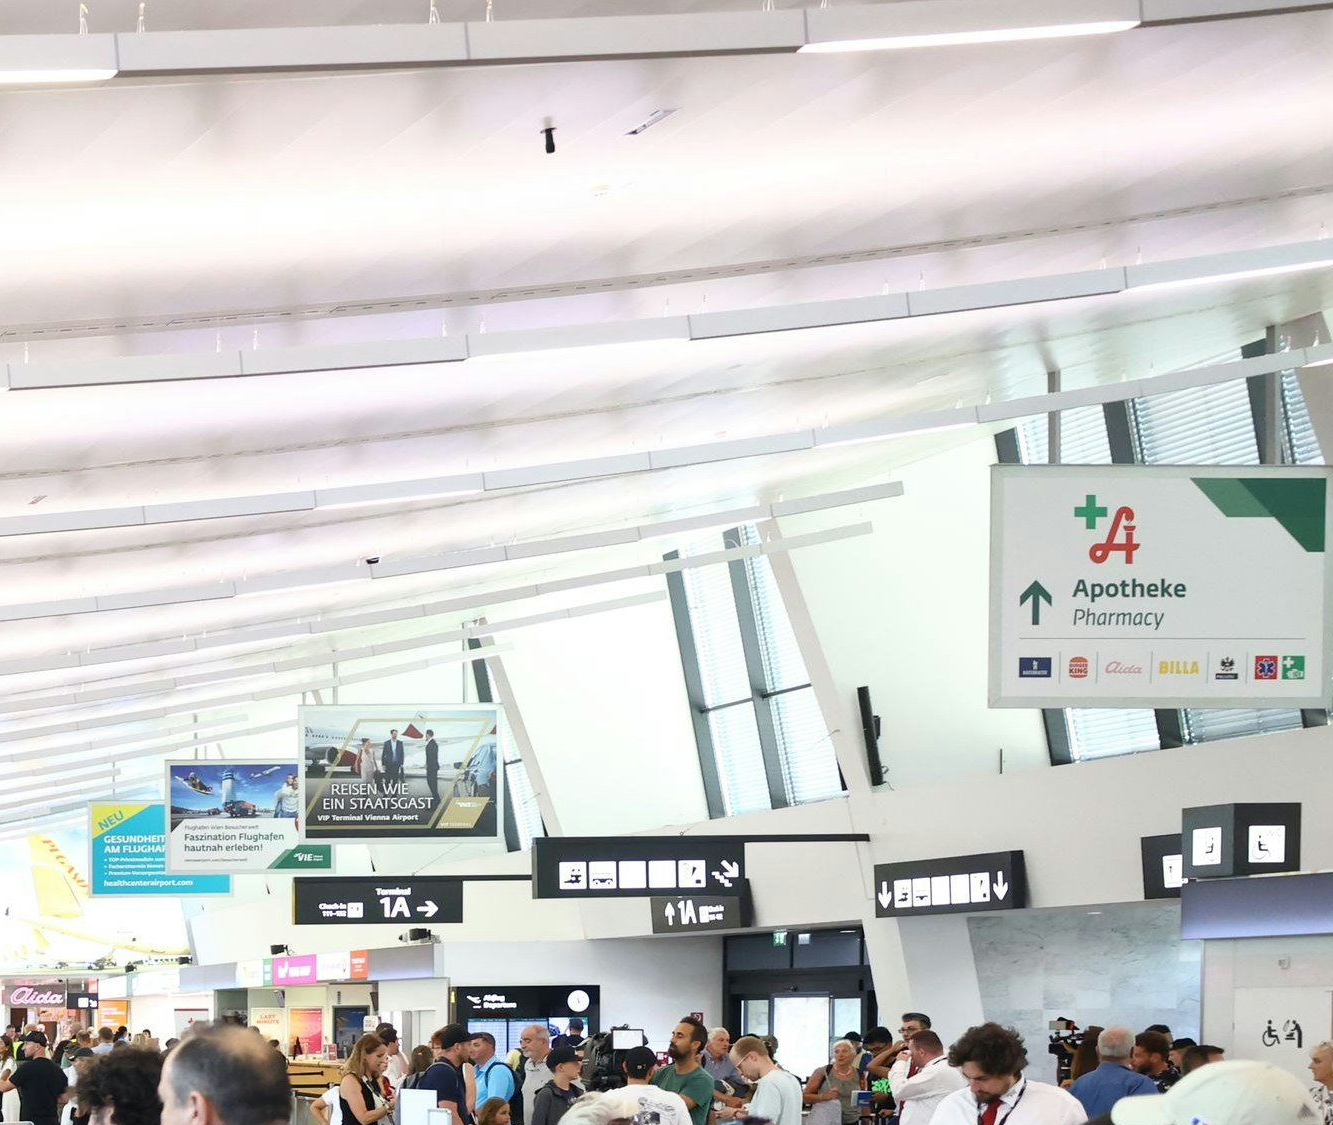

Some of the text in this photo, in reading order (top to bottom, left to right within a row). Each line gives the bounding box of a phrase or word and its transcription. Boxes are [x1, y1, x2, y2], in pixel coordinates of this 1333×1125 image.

[1072, 578, 1187, 603] Apotheke
[1073, 608, 1165, 631] Pharmacy
[1159, 660, 1199, 674] BILLA
[332, 783, 409, 795] REISEN WIE
[323, 797, 434, 810] EIN STAATSGAST
[98, 810, 124, 830] NEU
[317, 814, 330, 822] VIP
[392, 814, 419, 822] Airport
[184, 832, 284, 842] Faszination Flughafen
[104, 844, 165, 854] AM FLUGHAF
[184, 843, 263, 852] hautnah erleben!
[297, 853, 313, 862] VIE
[104, 879, 194, 888] healthcenterairport.com
[375, 887, 411, 896] Terminal
[379, 896, 411, 918] 1A
[677, 900, 697, 925] 1A
[10, 986, 64, 1005] Aida
